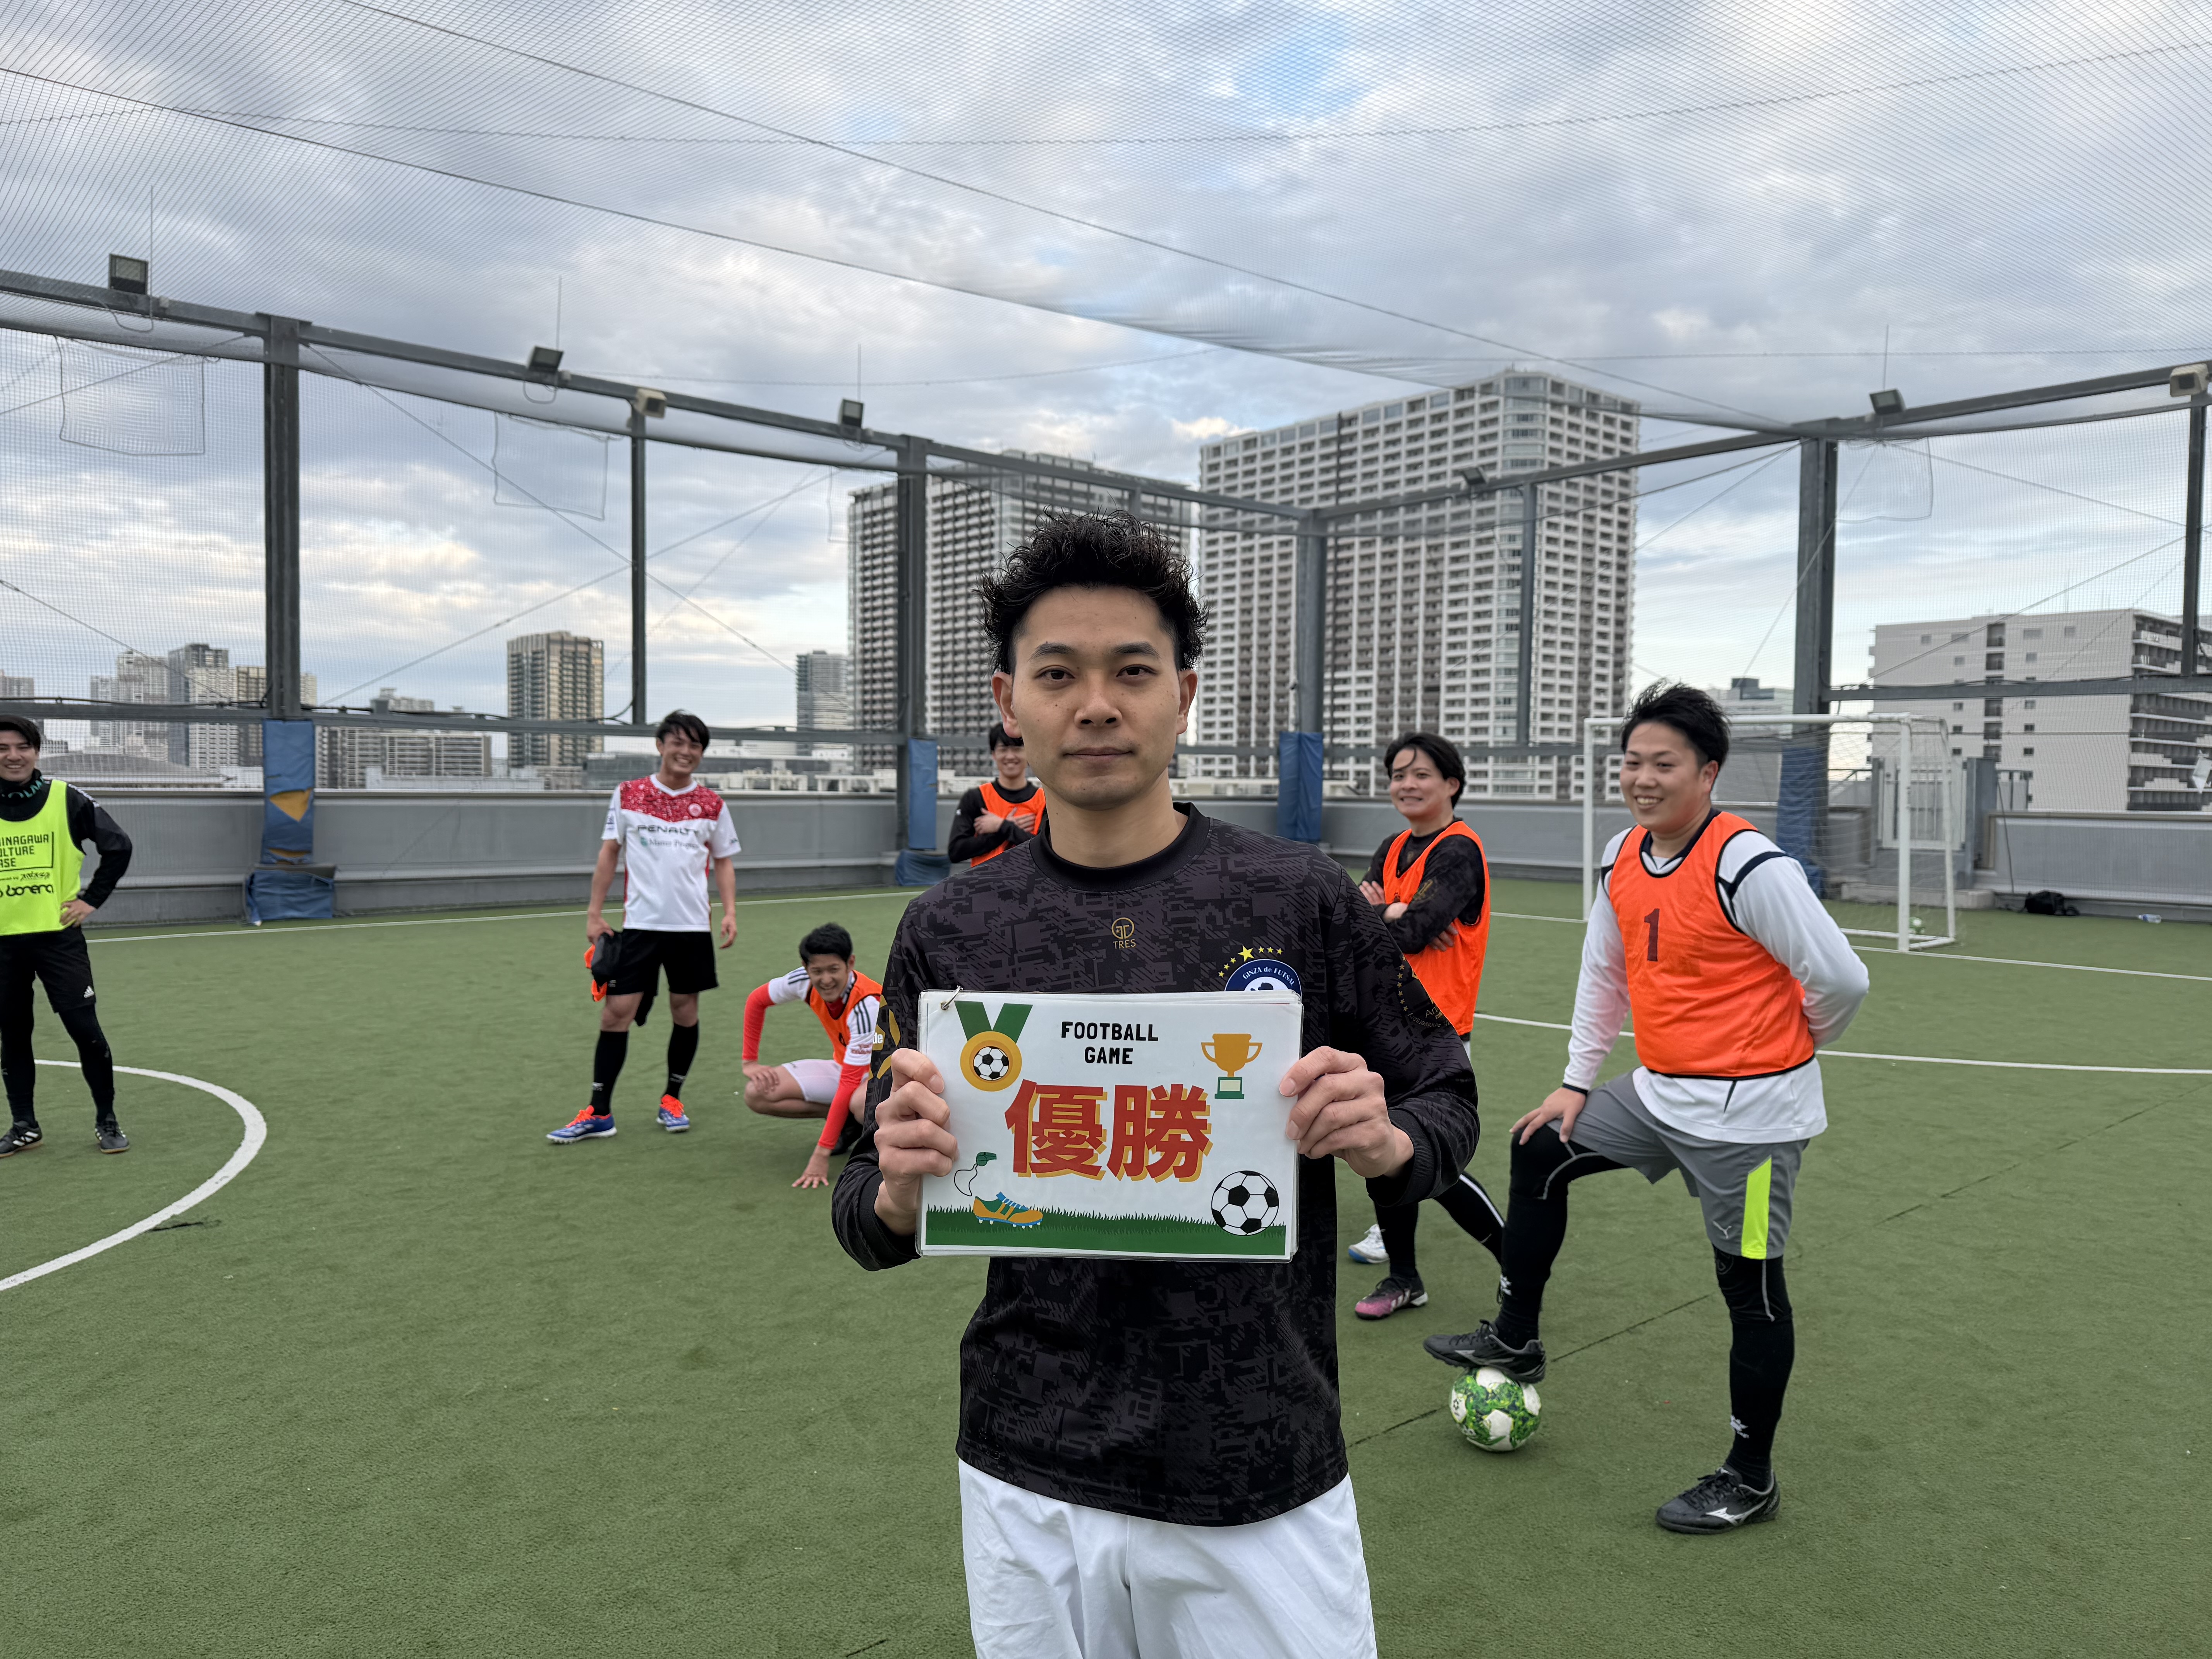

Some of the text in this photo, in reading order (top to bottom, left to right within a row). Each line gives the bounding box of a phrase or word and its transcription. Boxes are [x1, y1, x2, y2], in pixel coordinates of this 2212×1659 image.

[637, 824, 699, 835] PENALTY
[0, 834, 49, 847] INAGAWA
[1113, 939, 1136, 949] TRES
[1644, 908, 1660, 962] 1
[1243, 967, 1262, 979] GINZA
[1274, 968, 1295, 987] FUTSAL
[1061, 1021, 1159, 1041] FOOTBALL
[1084, 1046, 1133, 1065] GAME
[1004, 1079, 1214, 1183] 優勝
